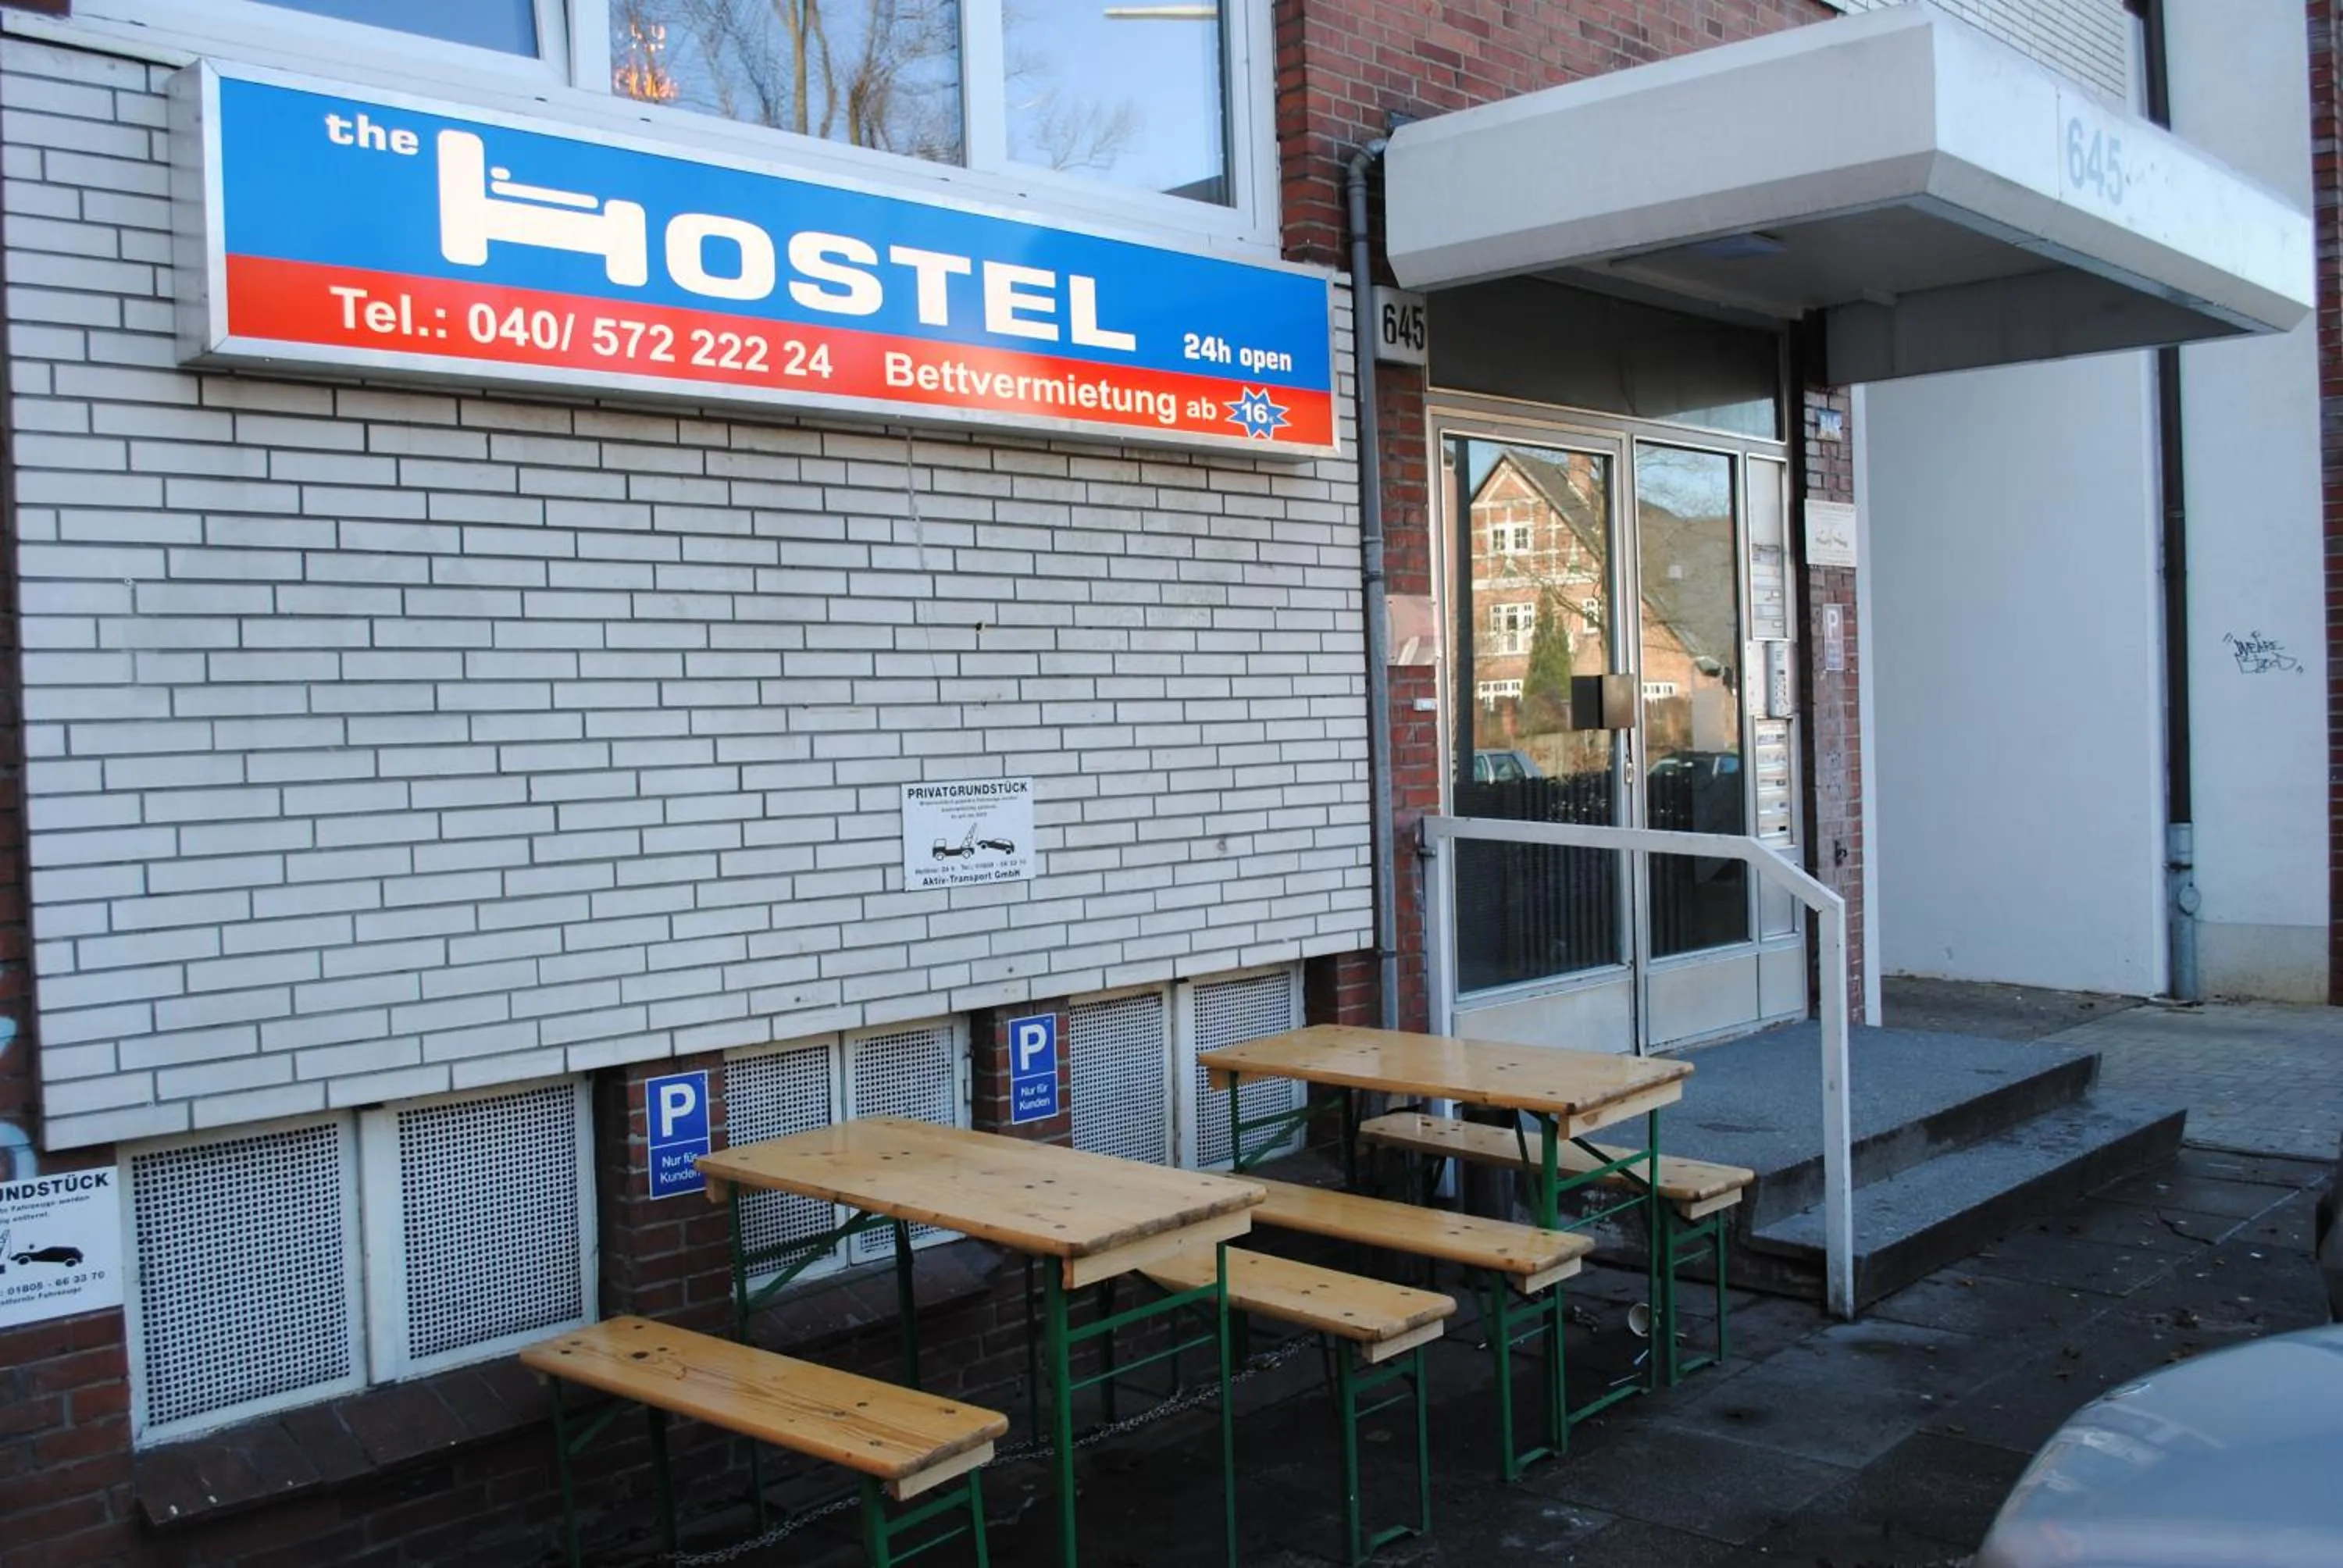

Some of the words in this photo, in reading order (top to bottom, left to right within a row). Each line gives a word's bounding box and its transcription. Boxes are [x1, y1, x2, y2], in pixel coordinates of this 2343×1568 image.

[2067, 117, 2122, 205] 645
[324, 112, 419, 155] the
[437, 129, 1136, 351] HOSTEL
[330, 286, 447, 337] Tel.:
[469, 303, 575, 351] 040/
[592, 318, 676, 362] 572
[690, 329, 769, 372] 222
[783, 340, 833, 380] 24
[1383, 304, 1425, 351] 645
[1183, 333, 1232, 364] 24h
[1239, 347, 1293, 373] open
[885, 351, 1177, 425] Bettvermietung
[1186, 397, 1218, 420] ab
[908, 782, 1028, 799] PRIVATGRUNDSTÜCK
[1019, 1024, 1047, 1071] P
[661, 1083, 696, 1138] P
[1019, 1097, 1050, 1110] Kunden
[1021, 1085, 1036, 1096] Nur
[1037, 1083, 1049, 1094] für
[662, 1156, 682, 1167] Nur
[0, 1172, 109, 1202] NDSTÜCK
